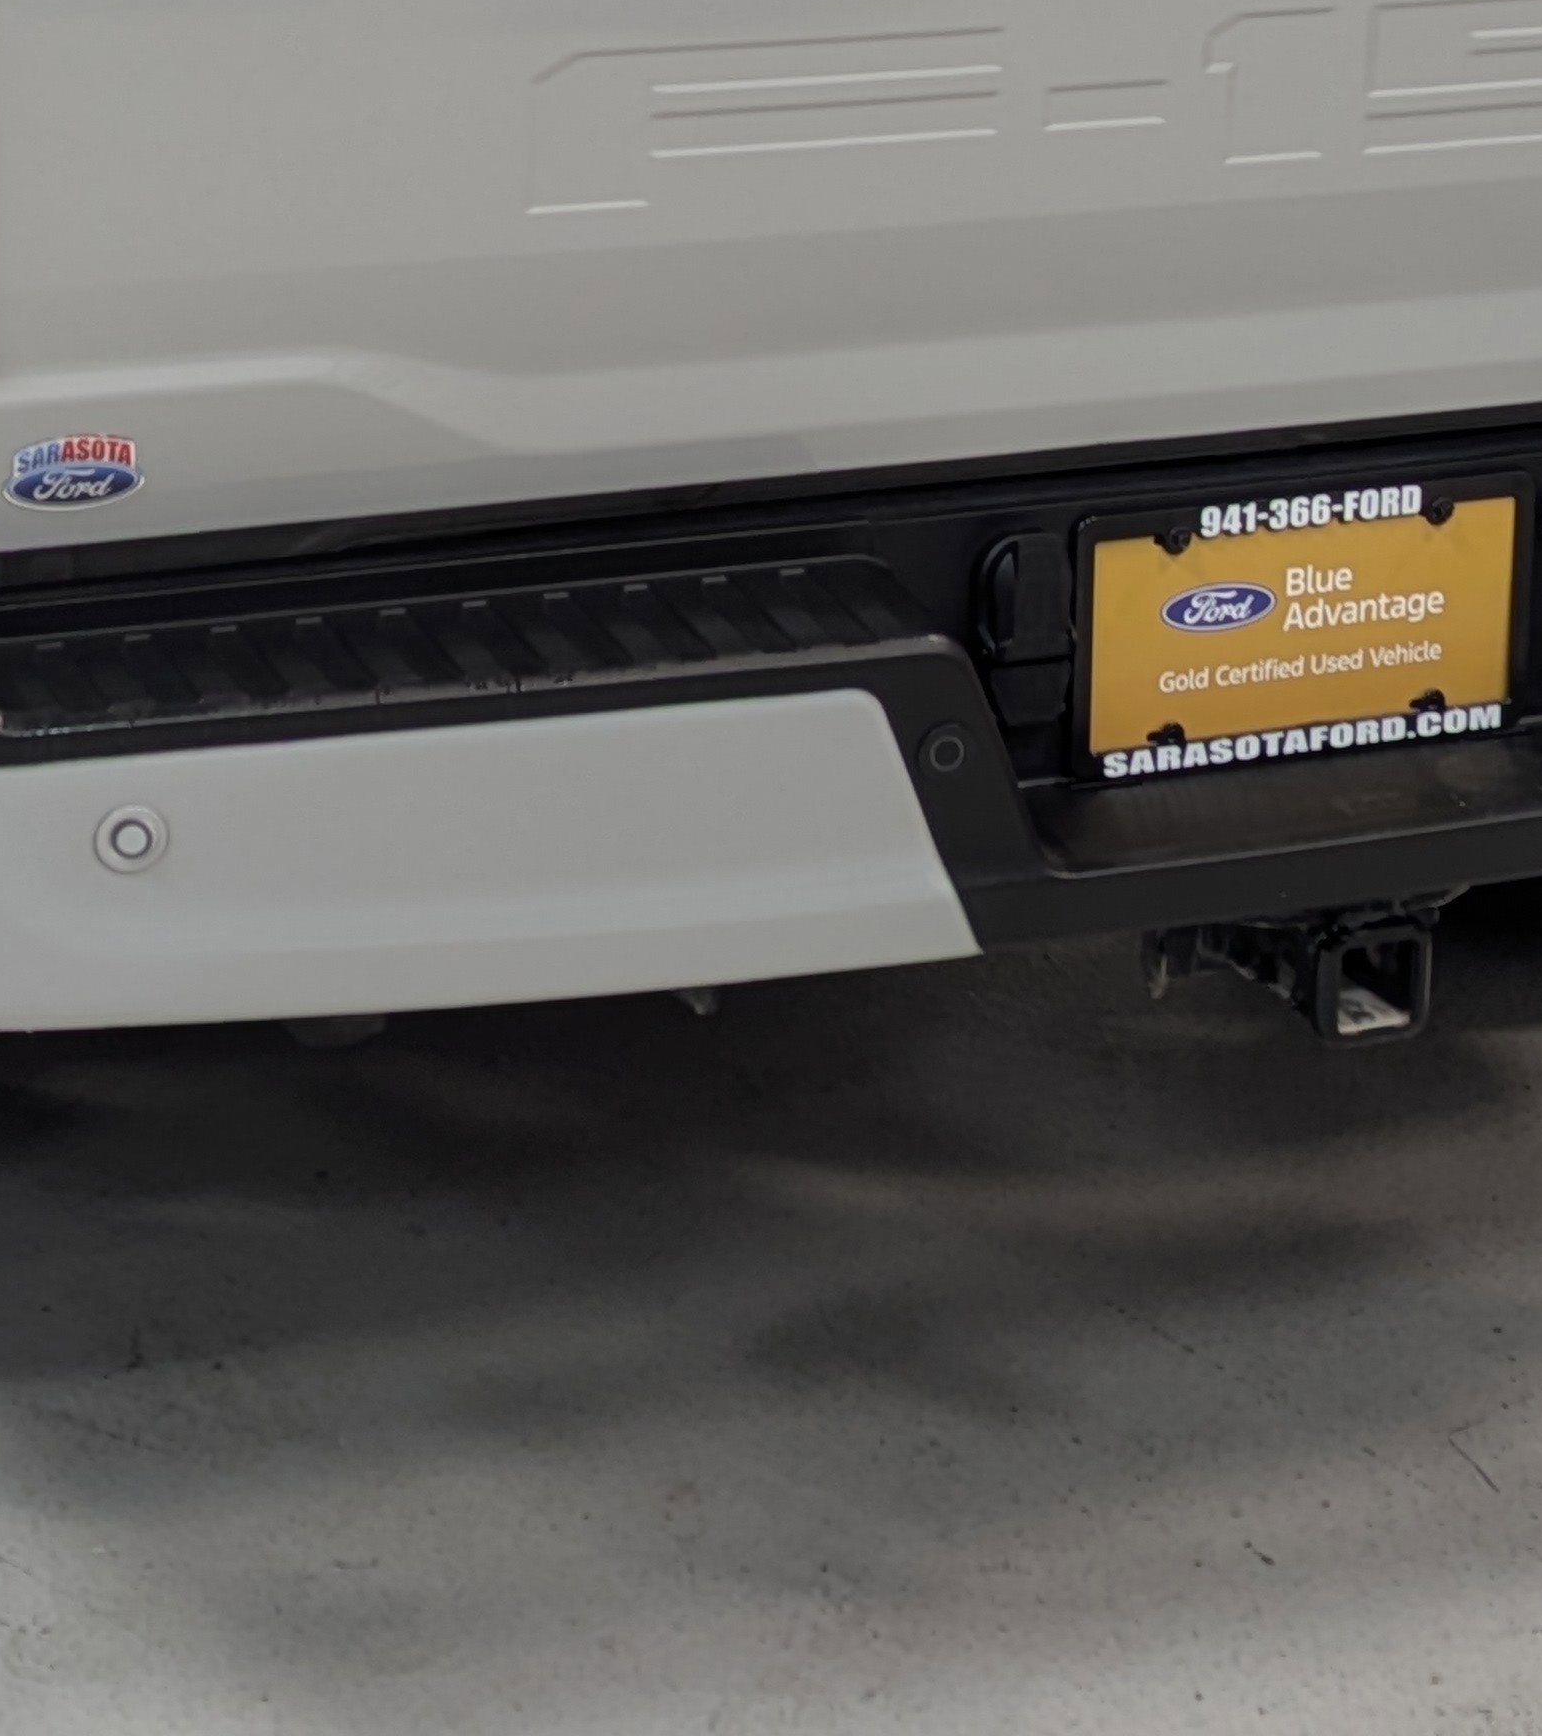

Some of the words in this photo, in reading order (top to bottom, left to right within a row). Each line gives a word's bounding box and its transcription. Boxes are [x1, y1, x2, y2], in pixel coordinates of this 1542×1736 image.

[17, 438, 132, 473] SARASOTA
[32, 467, 112, 501] Ford
[1199, 484, 1423, 538] 941-366-FORD
[1284, 564, 1353, 597] Blue
[1183, 589, 1253, 627] Ford
[1282, 587, 1445, 632] Advantage
[1159, 667, 1209, 694] Gold
[1215, 655, 1305, 688] Certified
[1310, 650, 1364, 676] Used
[1369, 638, 1443, 669] Vehicle
[1102, 703, 1503, 780] SARASOTAFORD.COM
